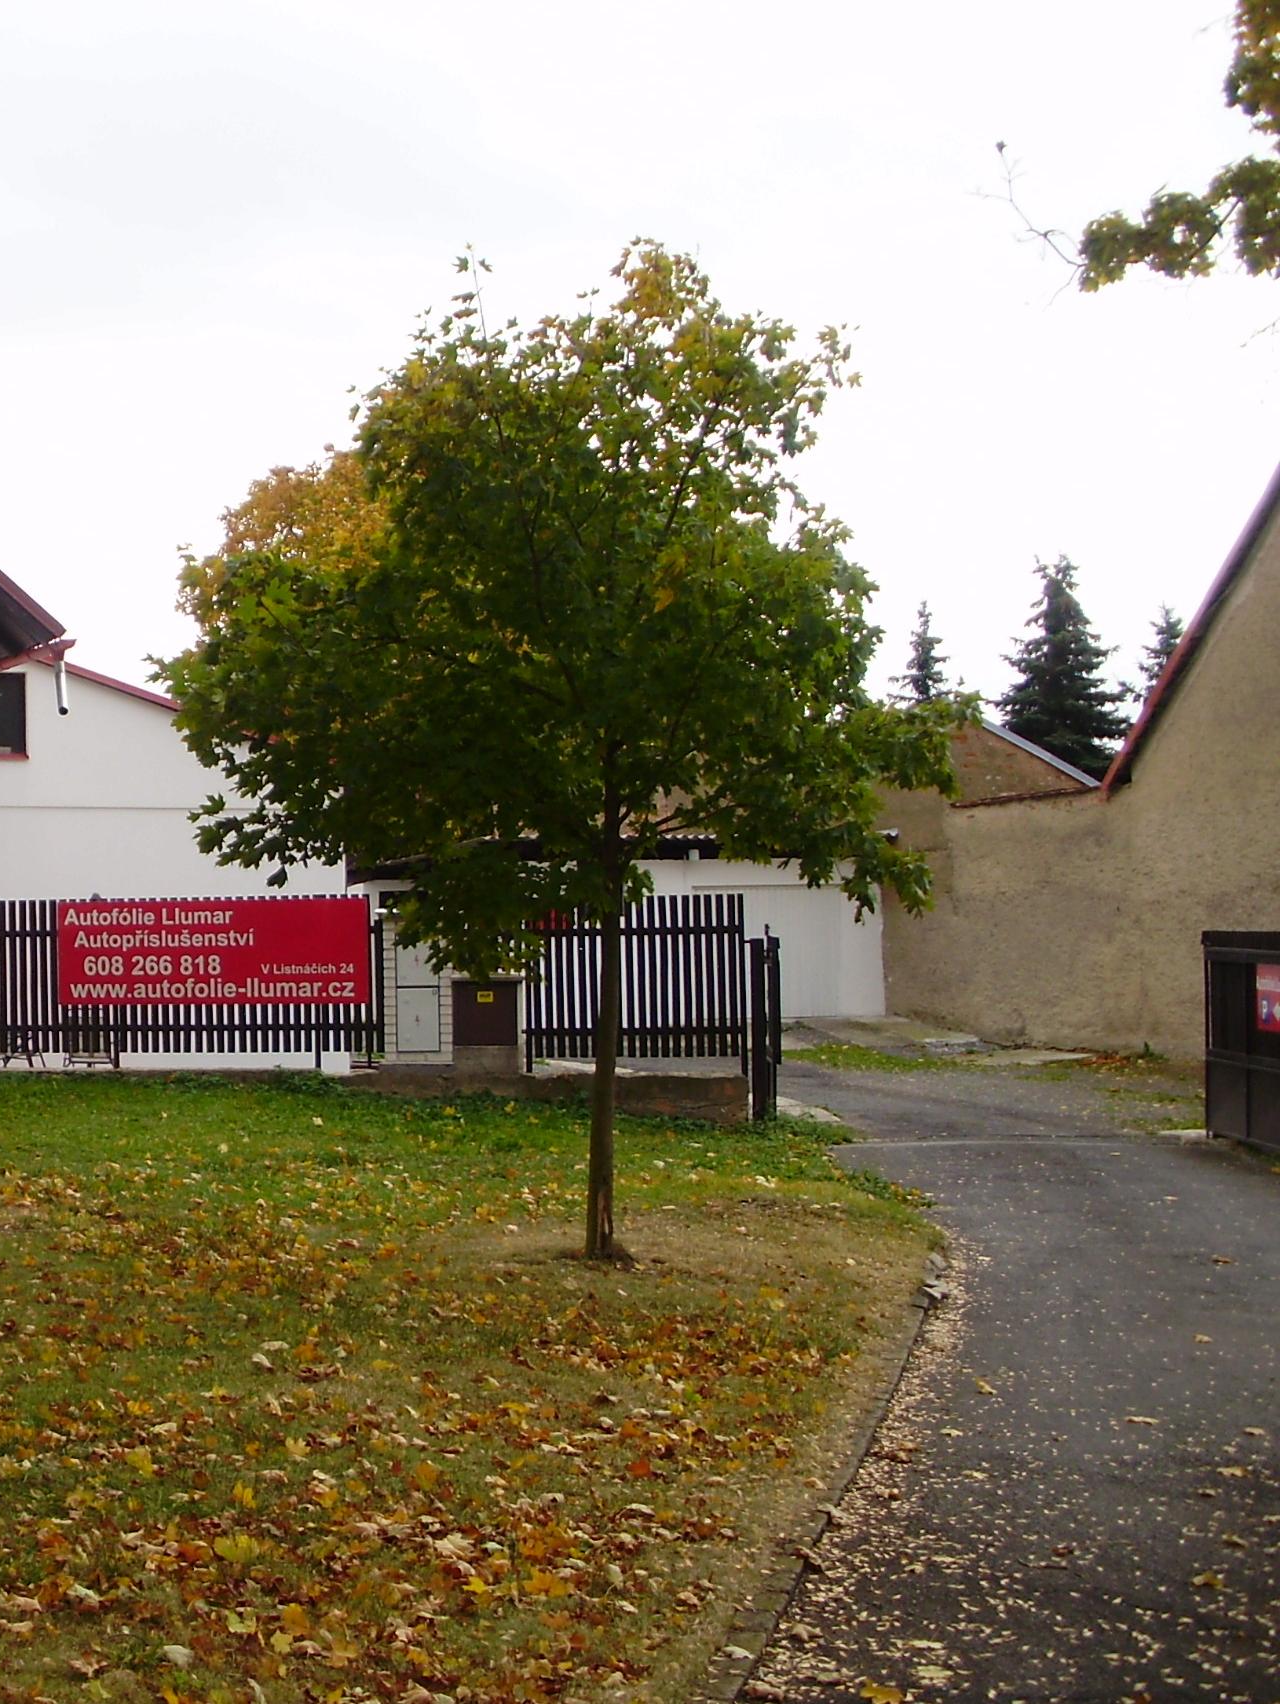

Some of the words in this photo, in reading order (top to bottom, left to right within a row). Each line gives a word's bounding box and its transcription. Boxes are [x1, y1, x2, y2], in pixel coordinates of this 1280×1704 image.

[64, 908, 155, 925] Autofólie
[162, 908, 233, 925] Llumar
[74, 928, 254, 951] Autopříslušenství
[84, 956, 124, 976] 608
[131, 956, 172, 976] 266
[180, 955, 221, 975] 818
[261, 964, 270, 974] V
[340, 963, 354, 974] 24
[71, 979, 355, 998] www.autofolie-llumar.cz
